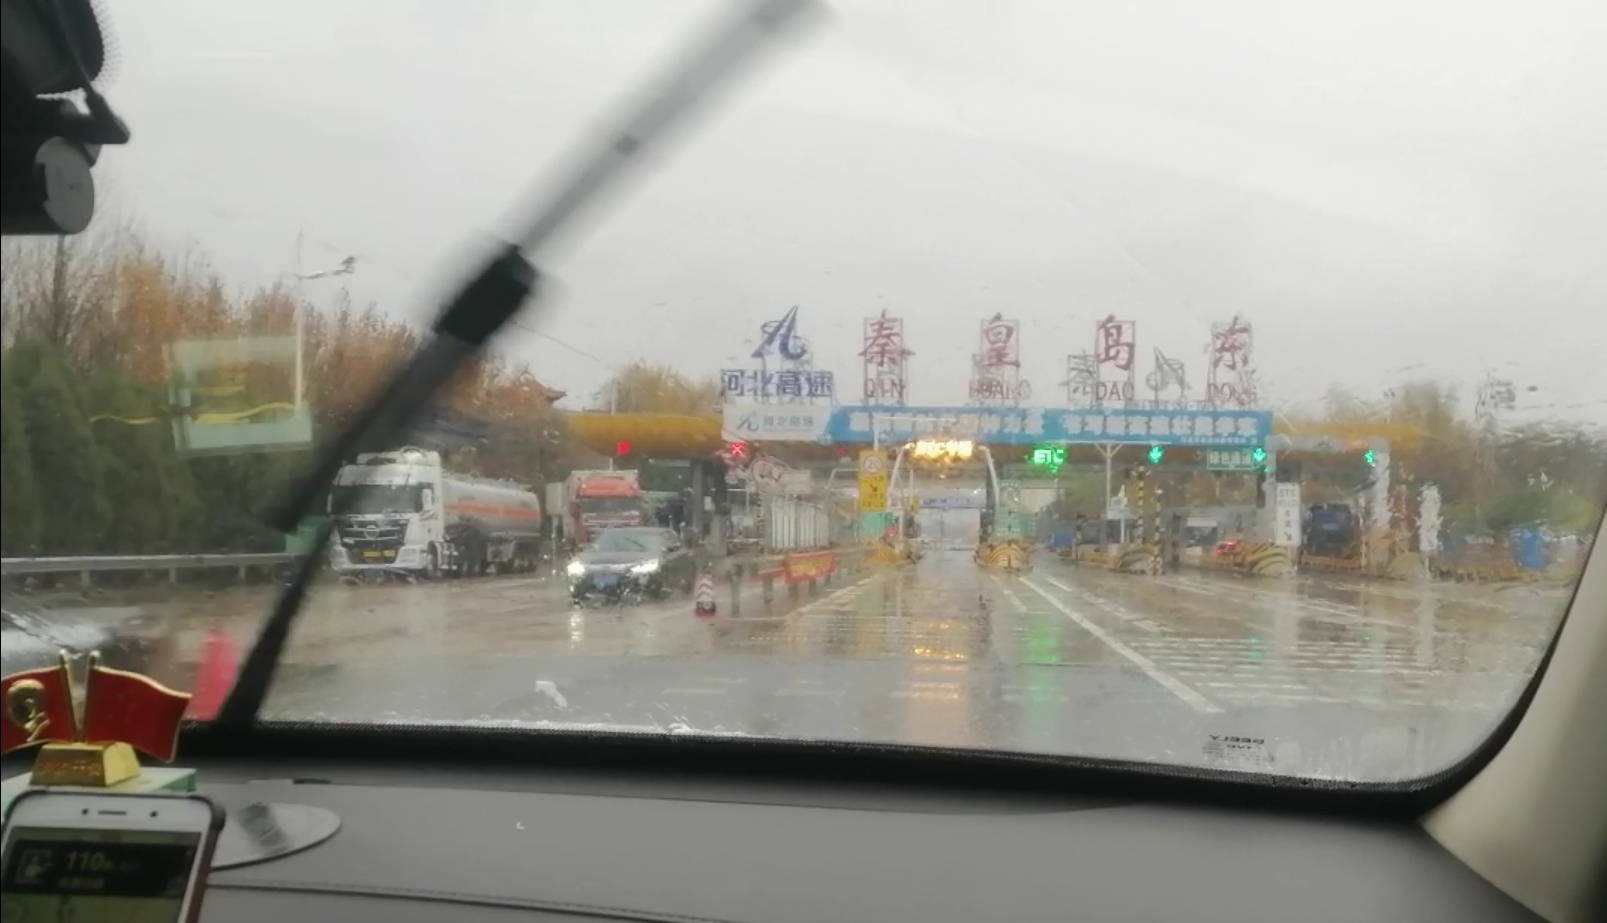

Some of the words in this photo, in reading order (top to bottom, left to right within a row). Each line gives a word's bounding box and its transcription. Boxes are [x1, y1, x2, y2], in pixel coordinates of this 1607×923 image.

[720, 369, 833, 397] 河北高速
[1096, 381, 1135, 401] DAO
